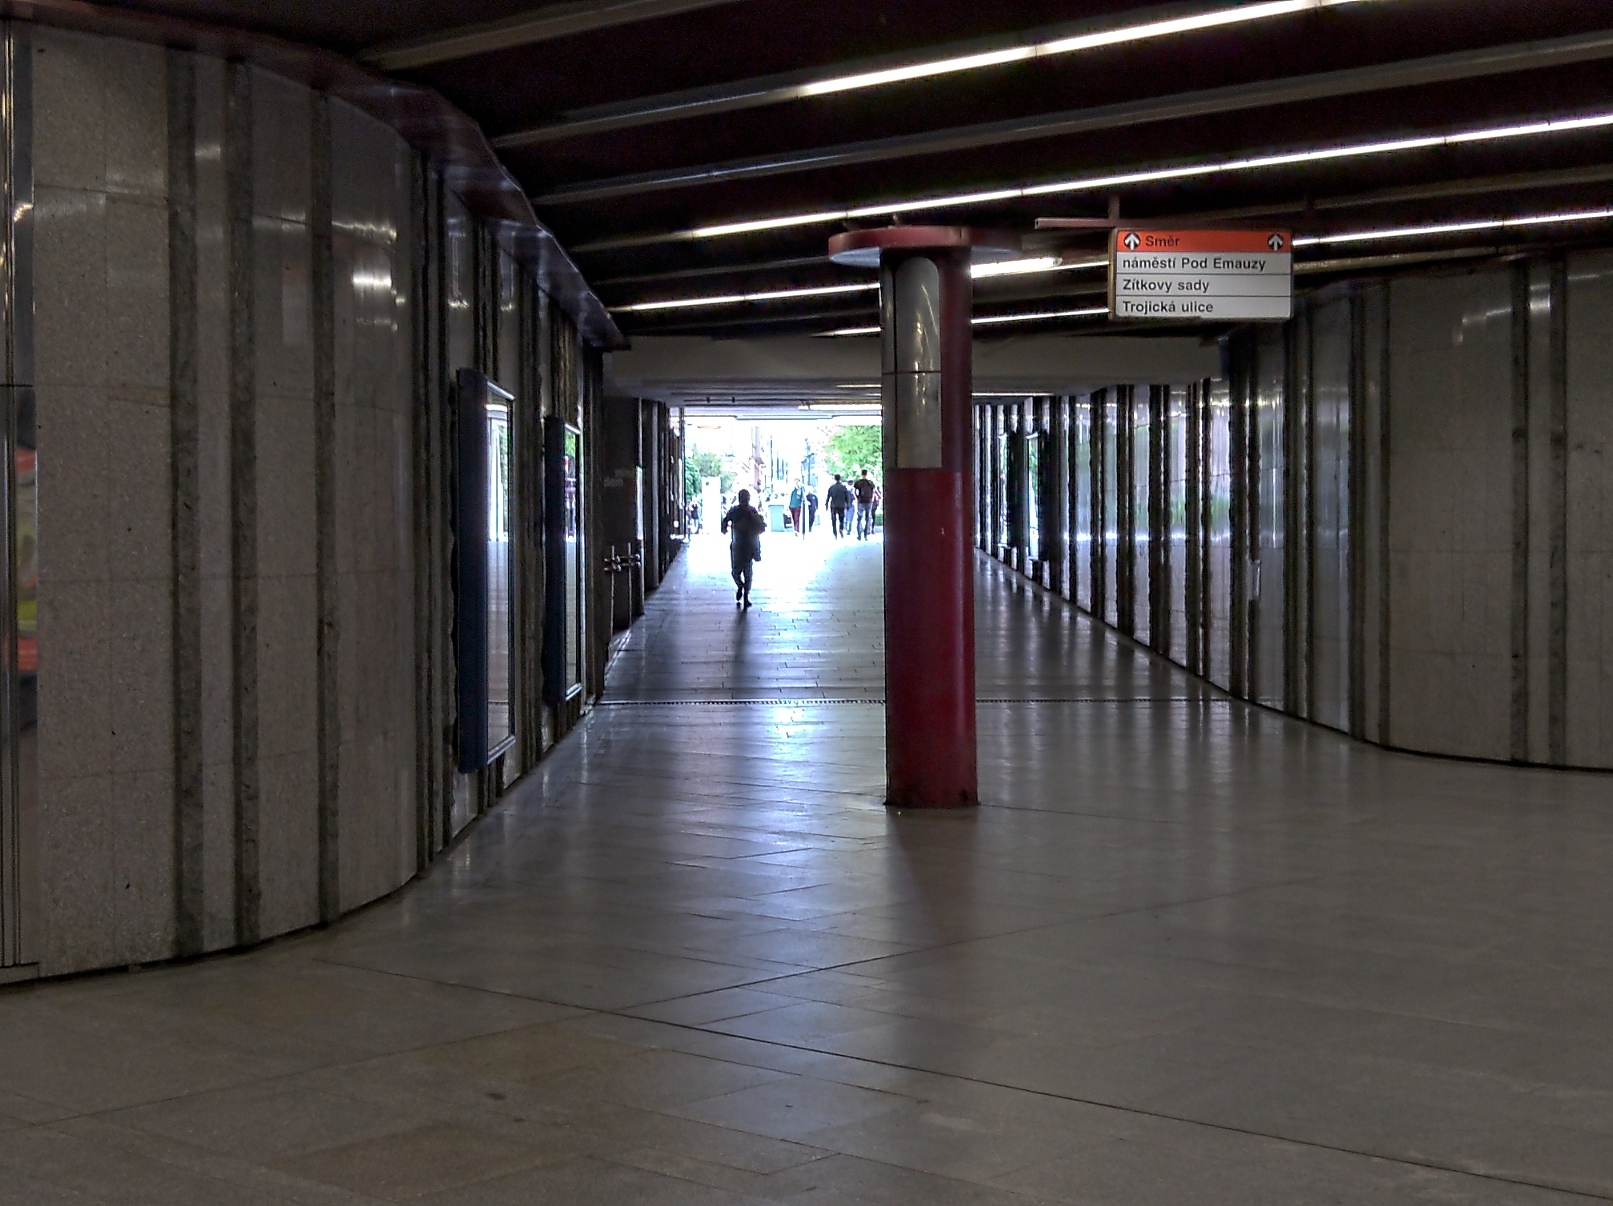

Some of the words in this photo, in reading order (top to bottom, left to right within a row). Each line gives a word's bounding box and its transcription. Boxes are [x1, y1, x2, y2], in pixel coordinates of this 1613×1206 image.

[1145, 235, 1180, 247] Směr
[1122, 257, 1176, 269] náměstí
[1181, 257, 1208, 269] Pod
[1213, 257, 1266, 272] Emauzy
[1122, 279, 1172, 293] Zítkovy
[1177, 279, 1210, 293] sady
[1122, 301, 1176, 315] Trojická
[1181, 301, 1214, 313] ulice
